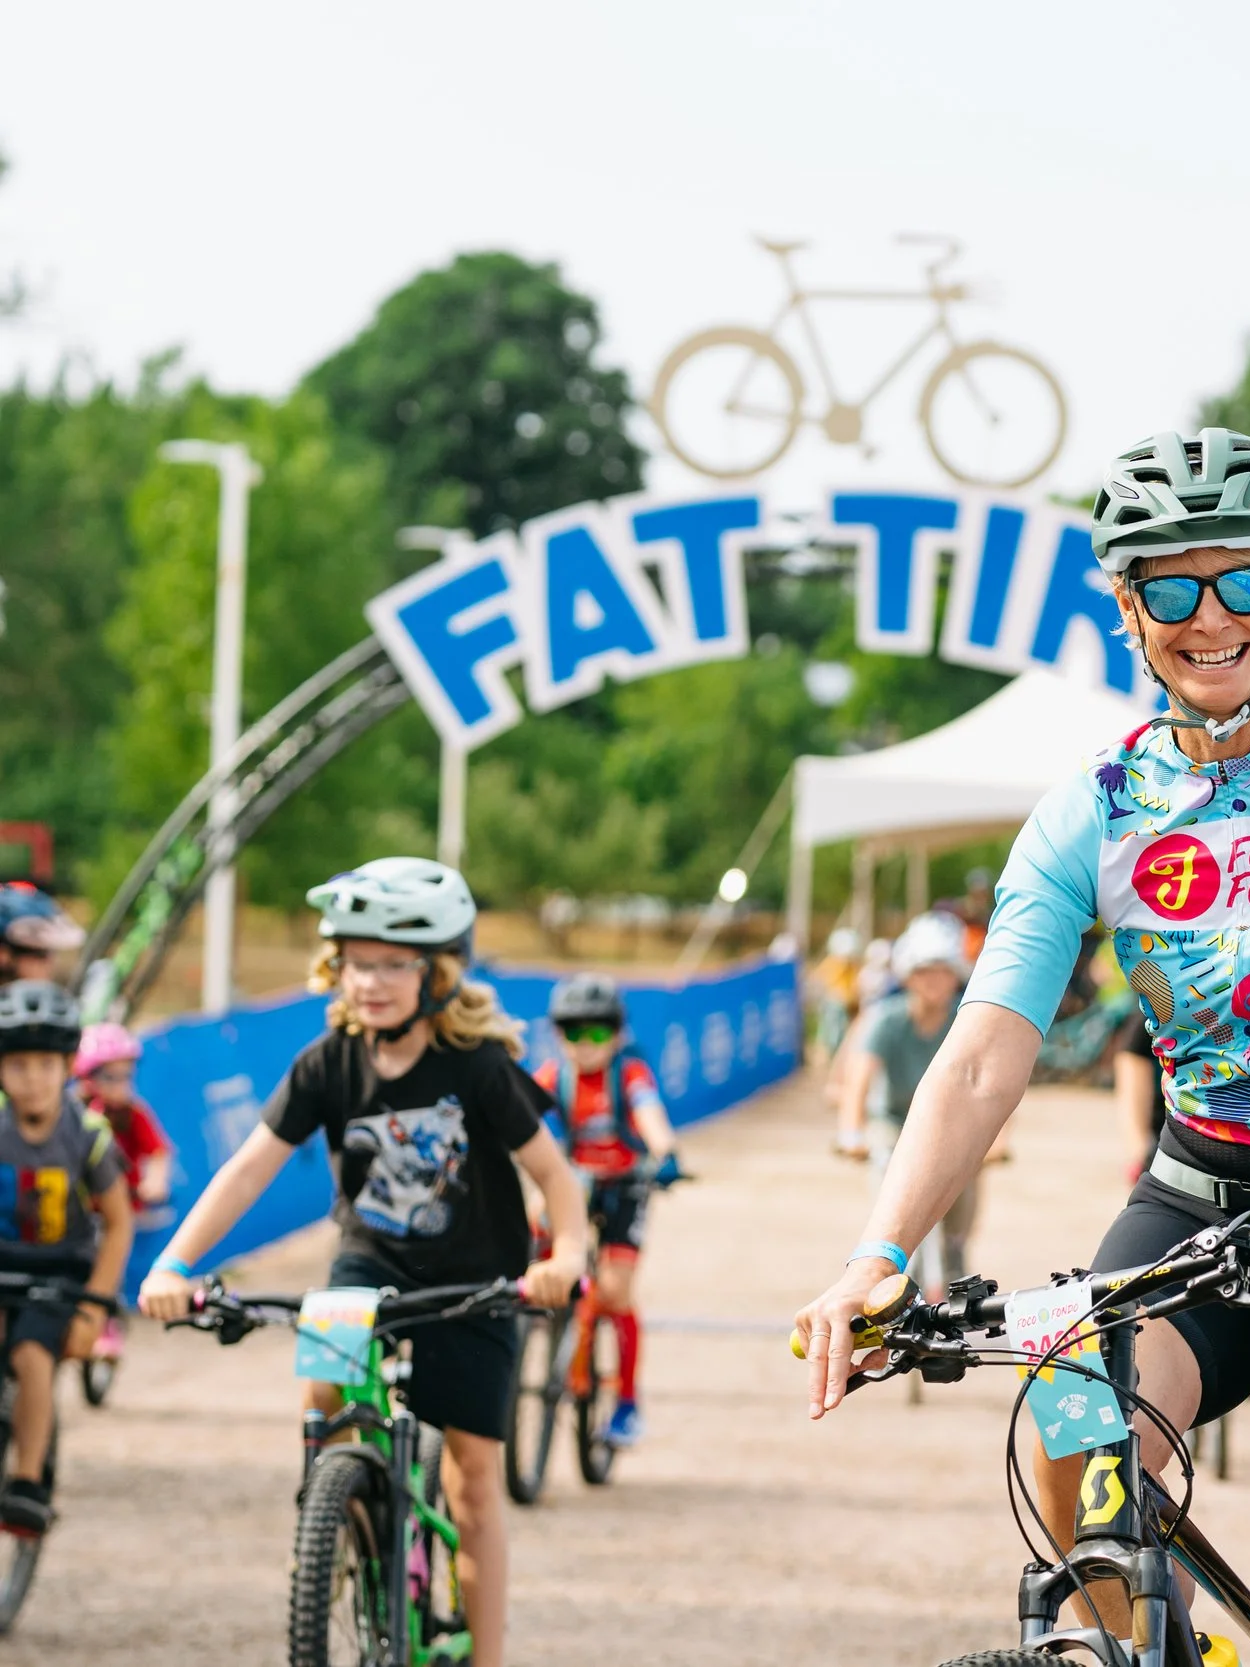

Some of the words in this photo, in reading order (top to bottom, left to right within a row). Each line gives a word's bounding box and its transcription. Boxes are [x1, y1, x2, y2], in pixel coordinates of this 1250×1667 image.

[396, 496, 758, 727] FAT
[1017, 1316, 1037, 1329] FOCO
[1051, 1304, 1079, 1319] FONDO
